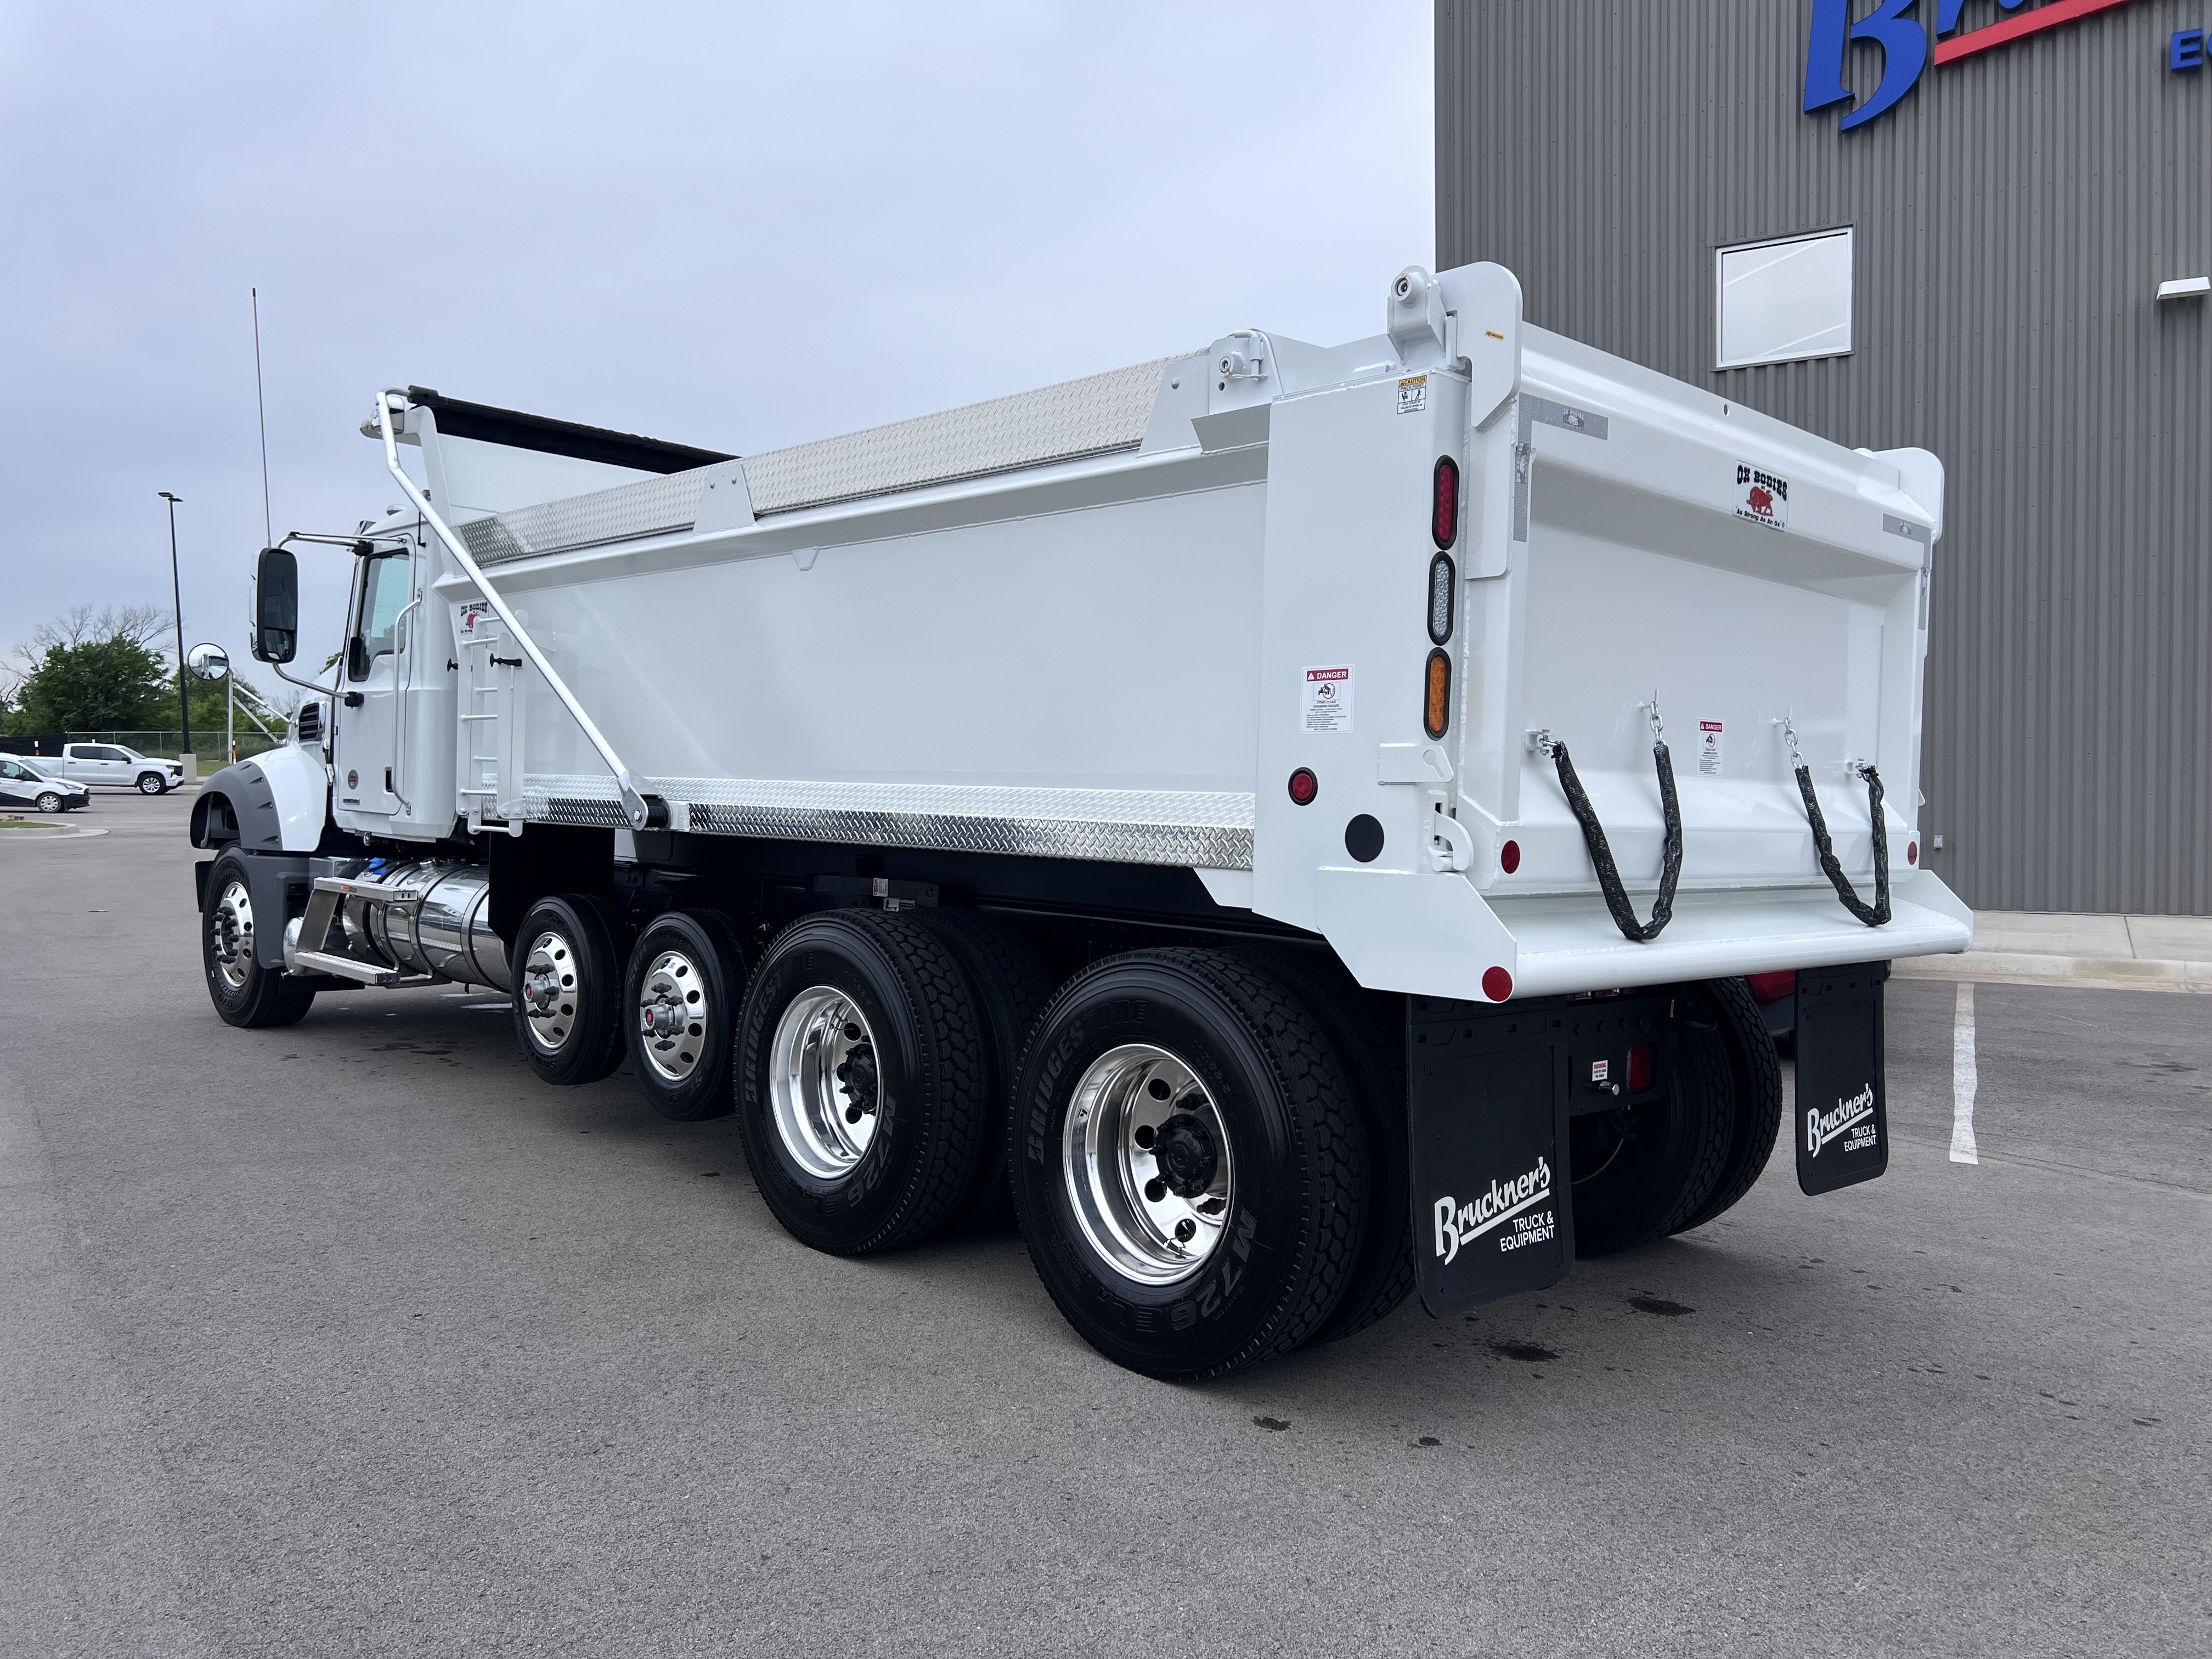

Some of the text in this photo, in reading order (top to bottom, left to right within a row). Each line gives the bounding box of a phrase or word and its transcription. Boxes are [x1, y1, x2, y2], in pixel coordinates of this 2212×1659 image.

[1404, 376, 1425, 385] CAUTION
[1736, 464, 1787, 502] OX BODIES
[1744, 510, 1759, 521] Strong
[1317, 671, 1347, 679] DANGER
[744, 950, 815, 1105] BRIDGESTONE
[1027, 999, 1149, 1166] BRIDGESTONE
[1807, 1083, 1873, 1158] Bruckner's
[1851, 1124, 1876, 1138] TRUCK &
[1844, 1135, 1876, 1152] EQUIPMENT
[1434, 1156, 1550, 1266] Bruckner's
[1513, 1210, 1554, 1233] TRUCK &
[1500, 1225, 1555, 1252] EQUIPMENT
